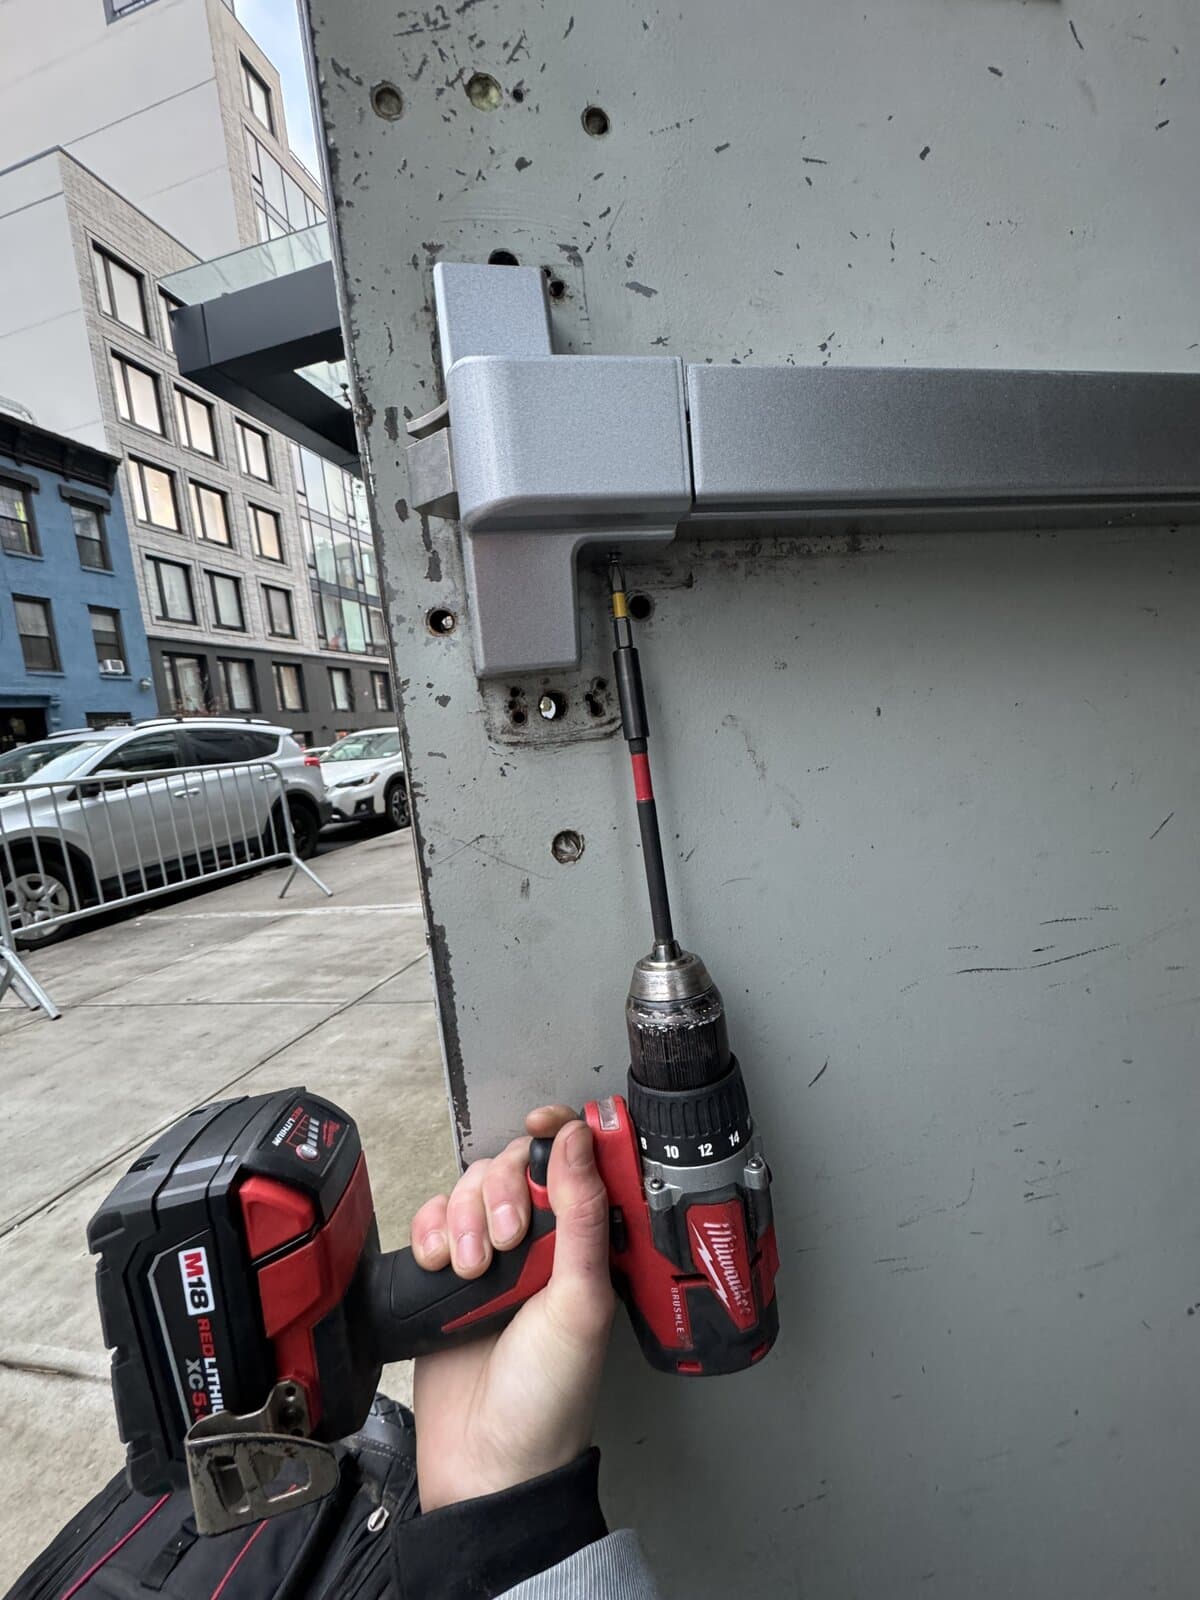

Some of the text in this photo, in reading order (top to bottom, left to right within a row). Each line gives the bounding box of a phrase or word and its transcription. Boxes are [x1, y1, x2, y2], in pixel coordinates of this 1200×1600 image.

[663, 1145, 680, 1159] 10
[697, 1143, 713, 1157] 12
[728, 1130, 740, 1147] 14
[183, 1252, 210, 1309] M18
[703, 1222, 752, 1315] Milwaukee
[185, 1358, 205, 1391] XC
[197, 1318, 225, 1414] REDLITHIU
